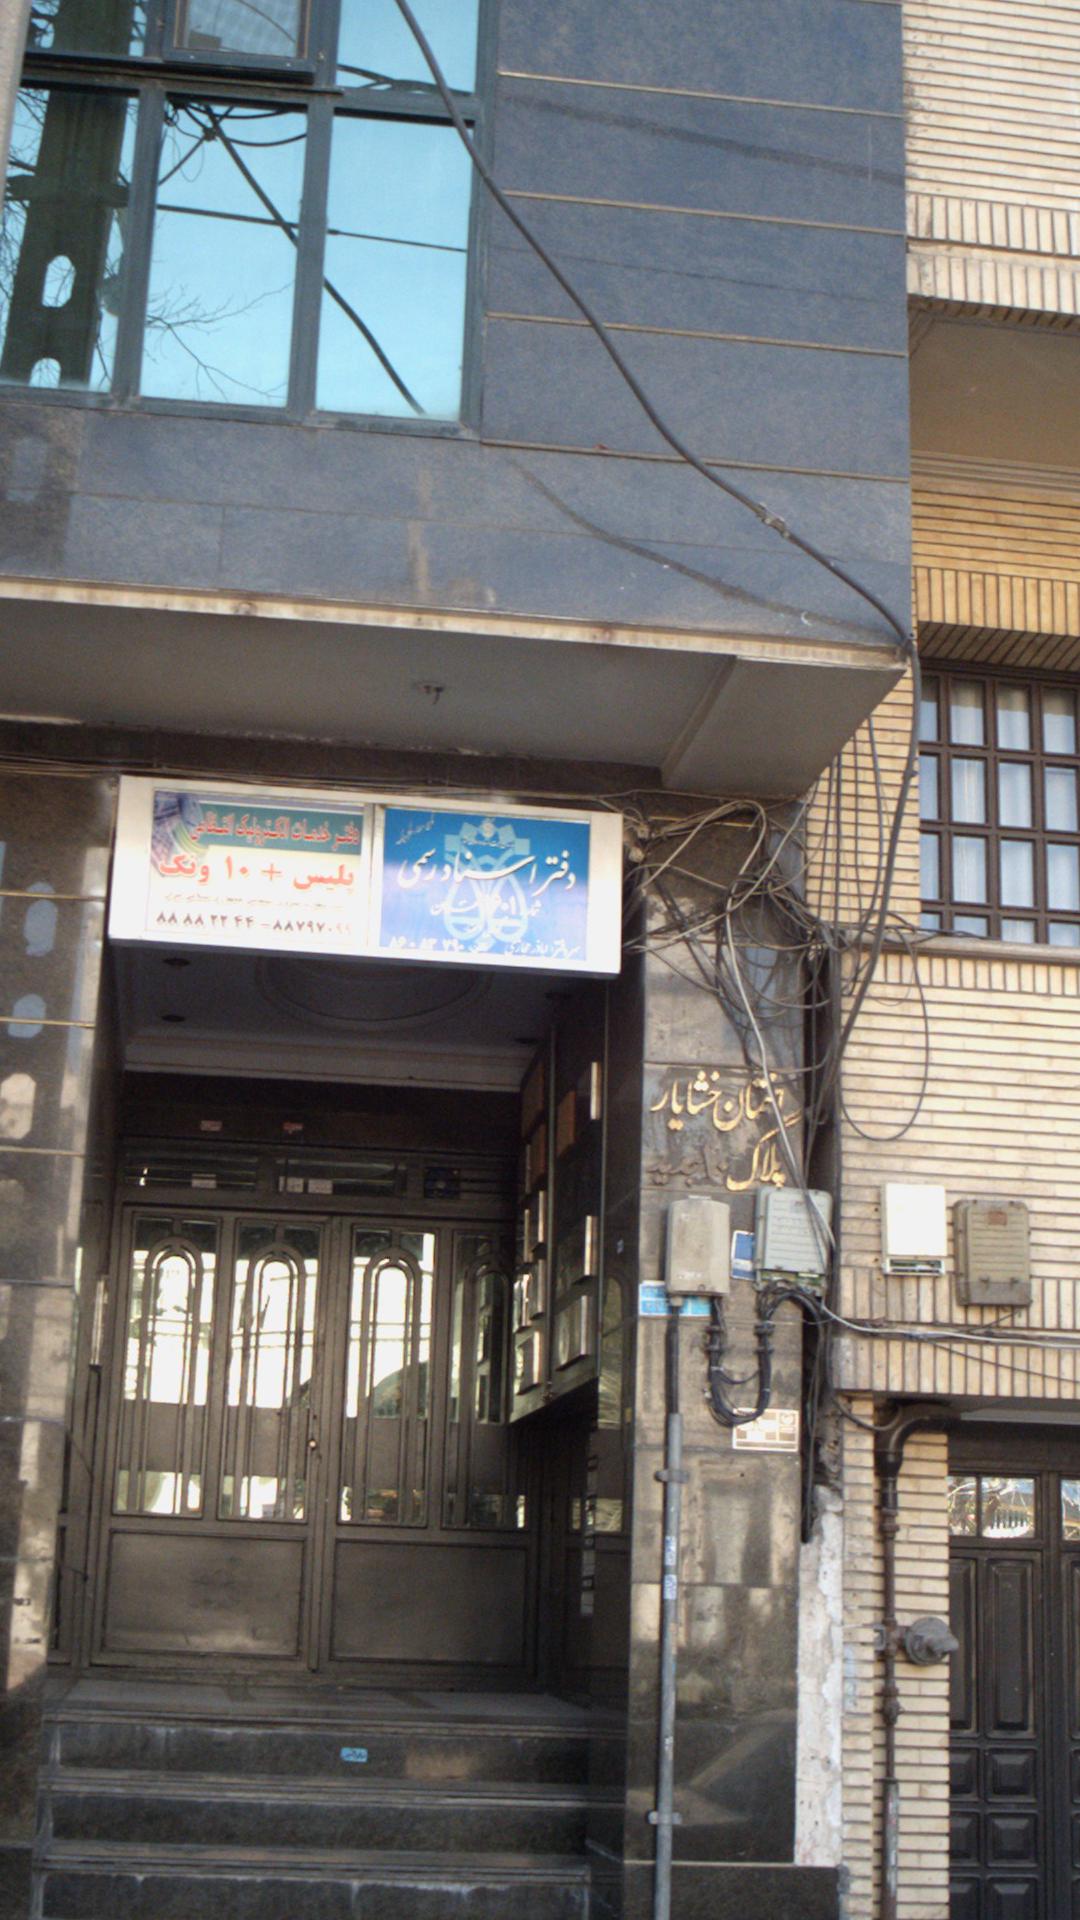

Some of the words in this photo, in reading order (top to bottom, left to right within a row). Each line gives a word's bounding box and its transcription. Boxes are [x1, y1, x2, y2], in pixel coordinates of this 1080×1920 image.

[291, 820, 331, 844] خدمات
[158, 853, 211, 884] ونک
[224, 854, 249, 880] ۱۰
[293, 863, 355, 894] پلیس
[397, 847, 436, 889] رسمی
[440, 850, 537, 884] اسناد
[531, 848, 577, 896] دفتر
[650, 1070, 722, 1131] خشایار
[727, 1110, 802, 1191] پلاک
